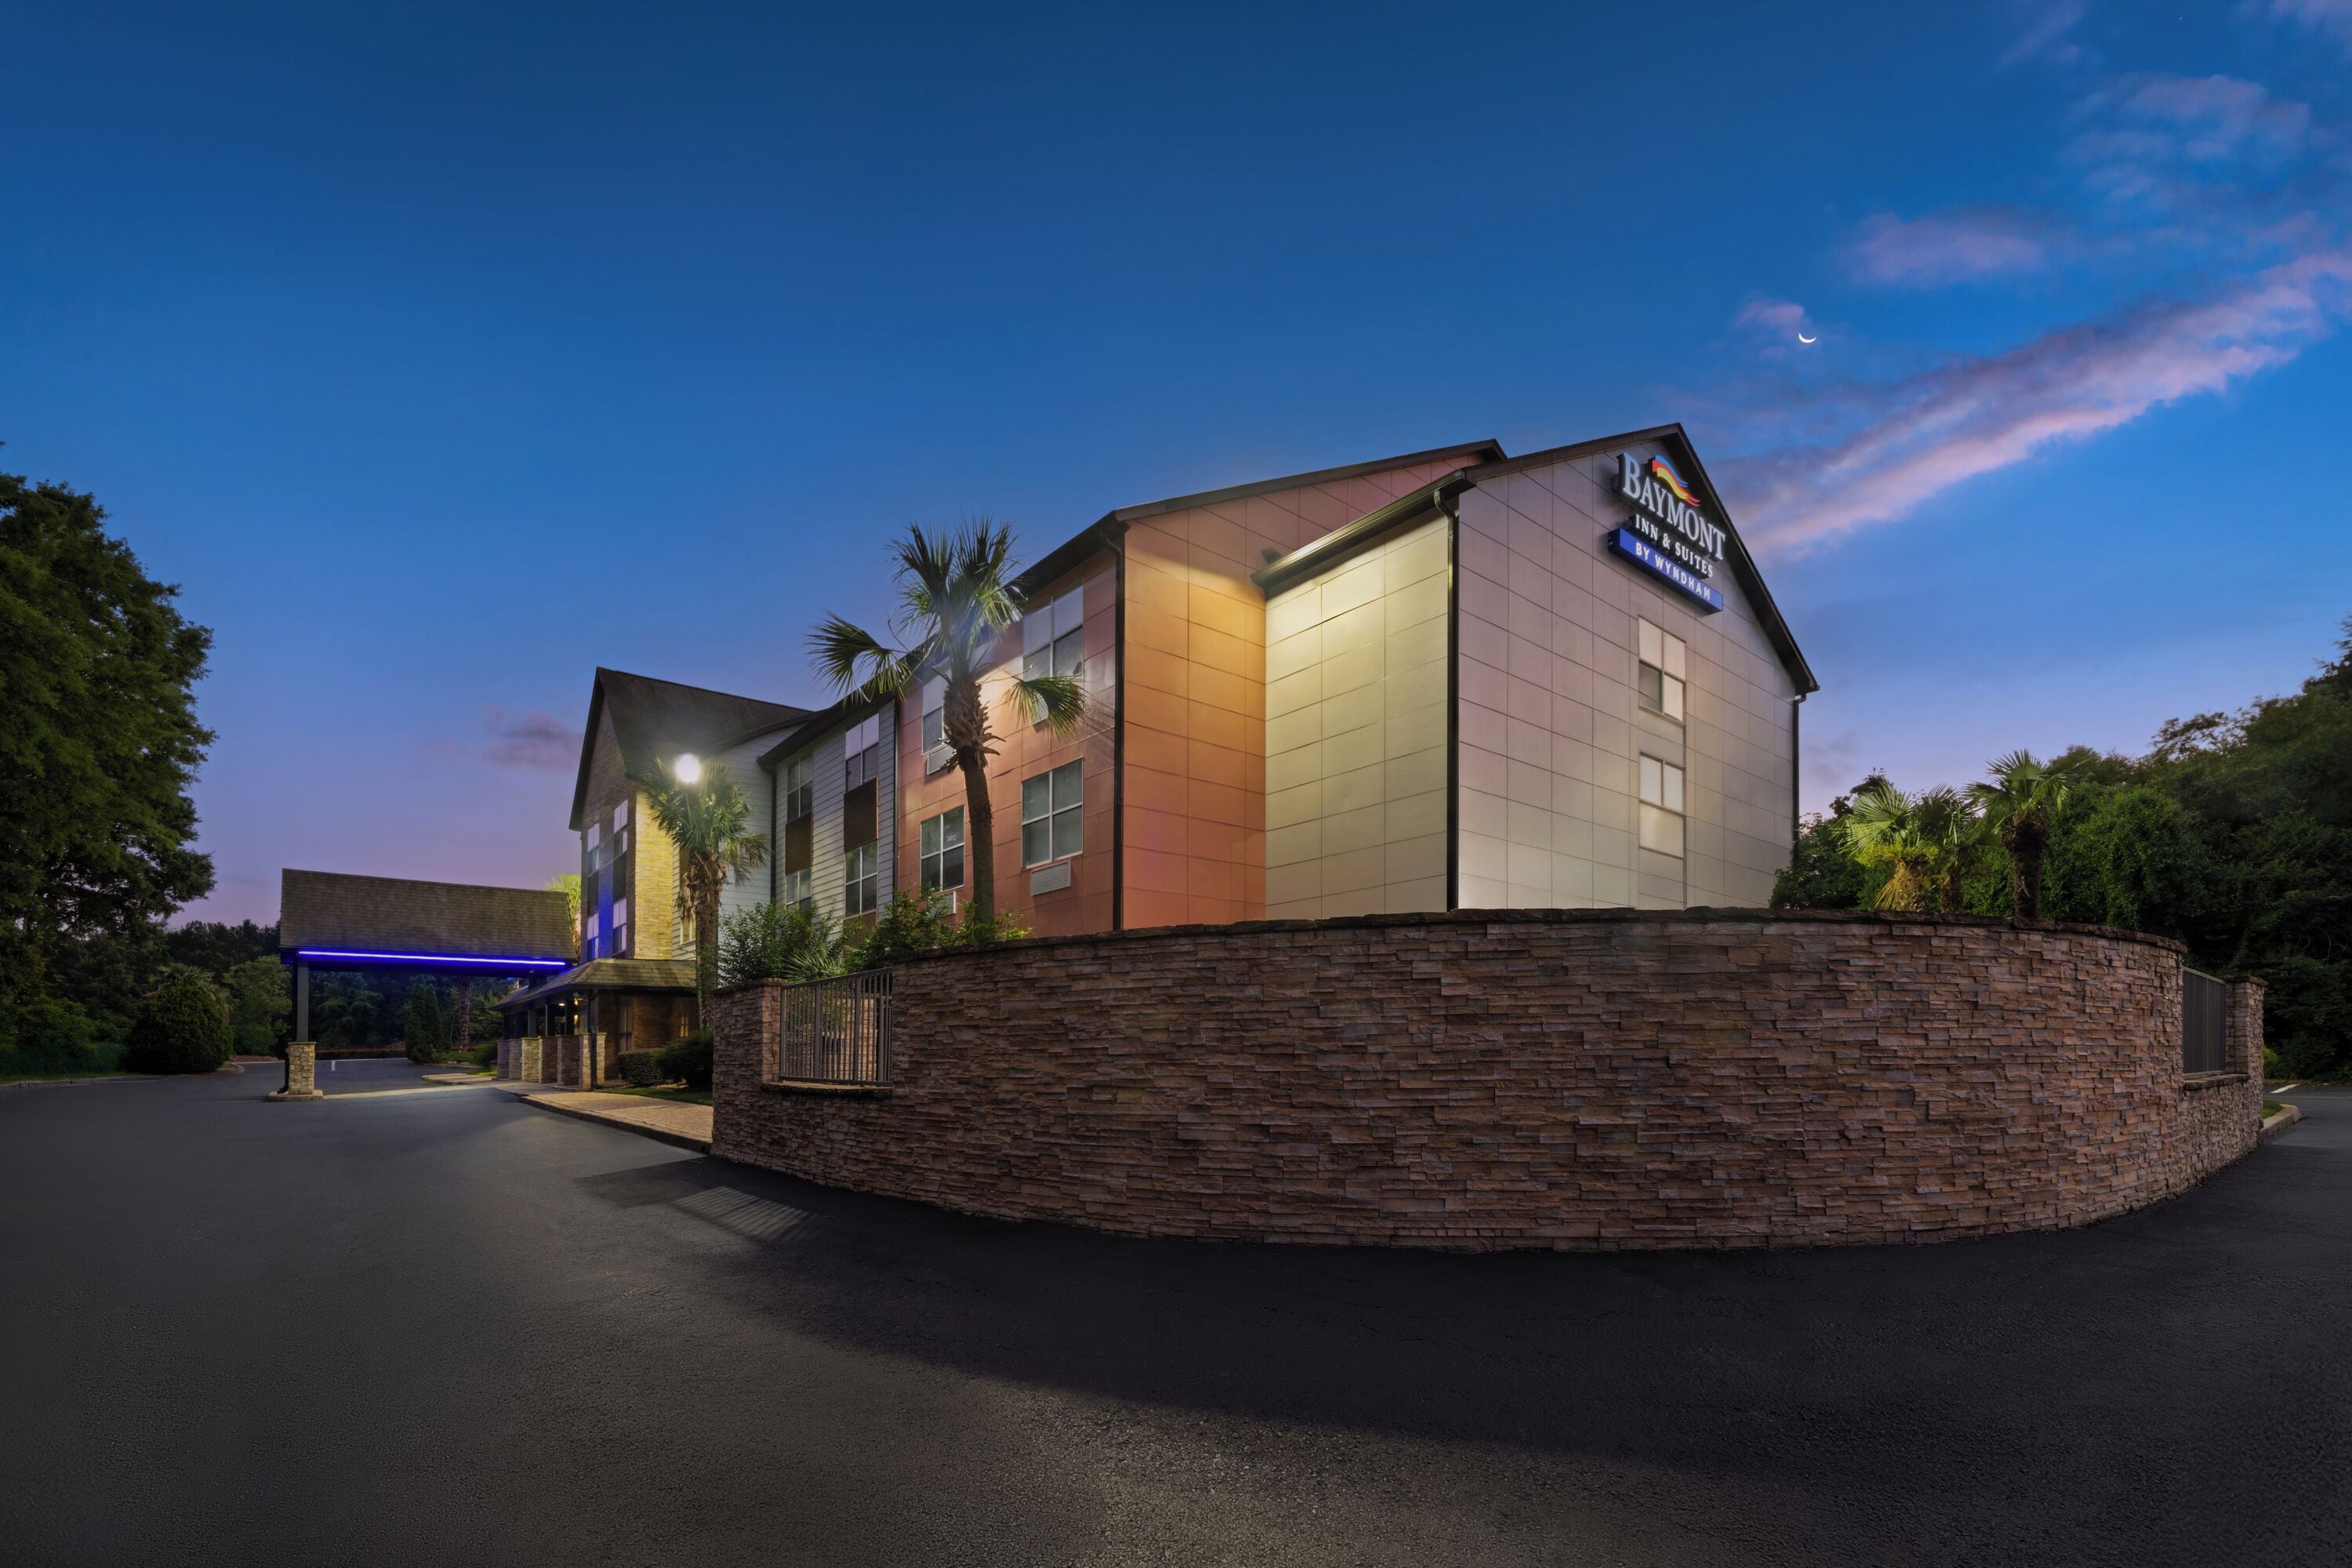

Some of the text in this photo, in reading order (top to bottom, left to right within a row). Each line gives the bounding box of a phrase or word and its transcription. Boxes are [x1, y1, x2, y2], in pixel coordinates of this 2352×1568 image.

[1623, 452, 1726, 561] BAYMONT
[1635, 514, 1713, 579] INN & SUITES
[1635, 542, 1711, 601] BY WYNDHAM
